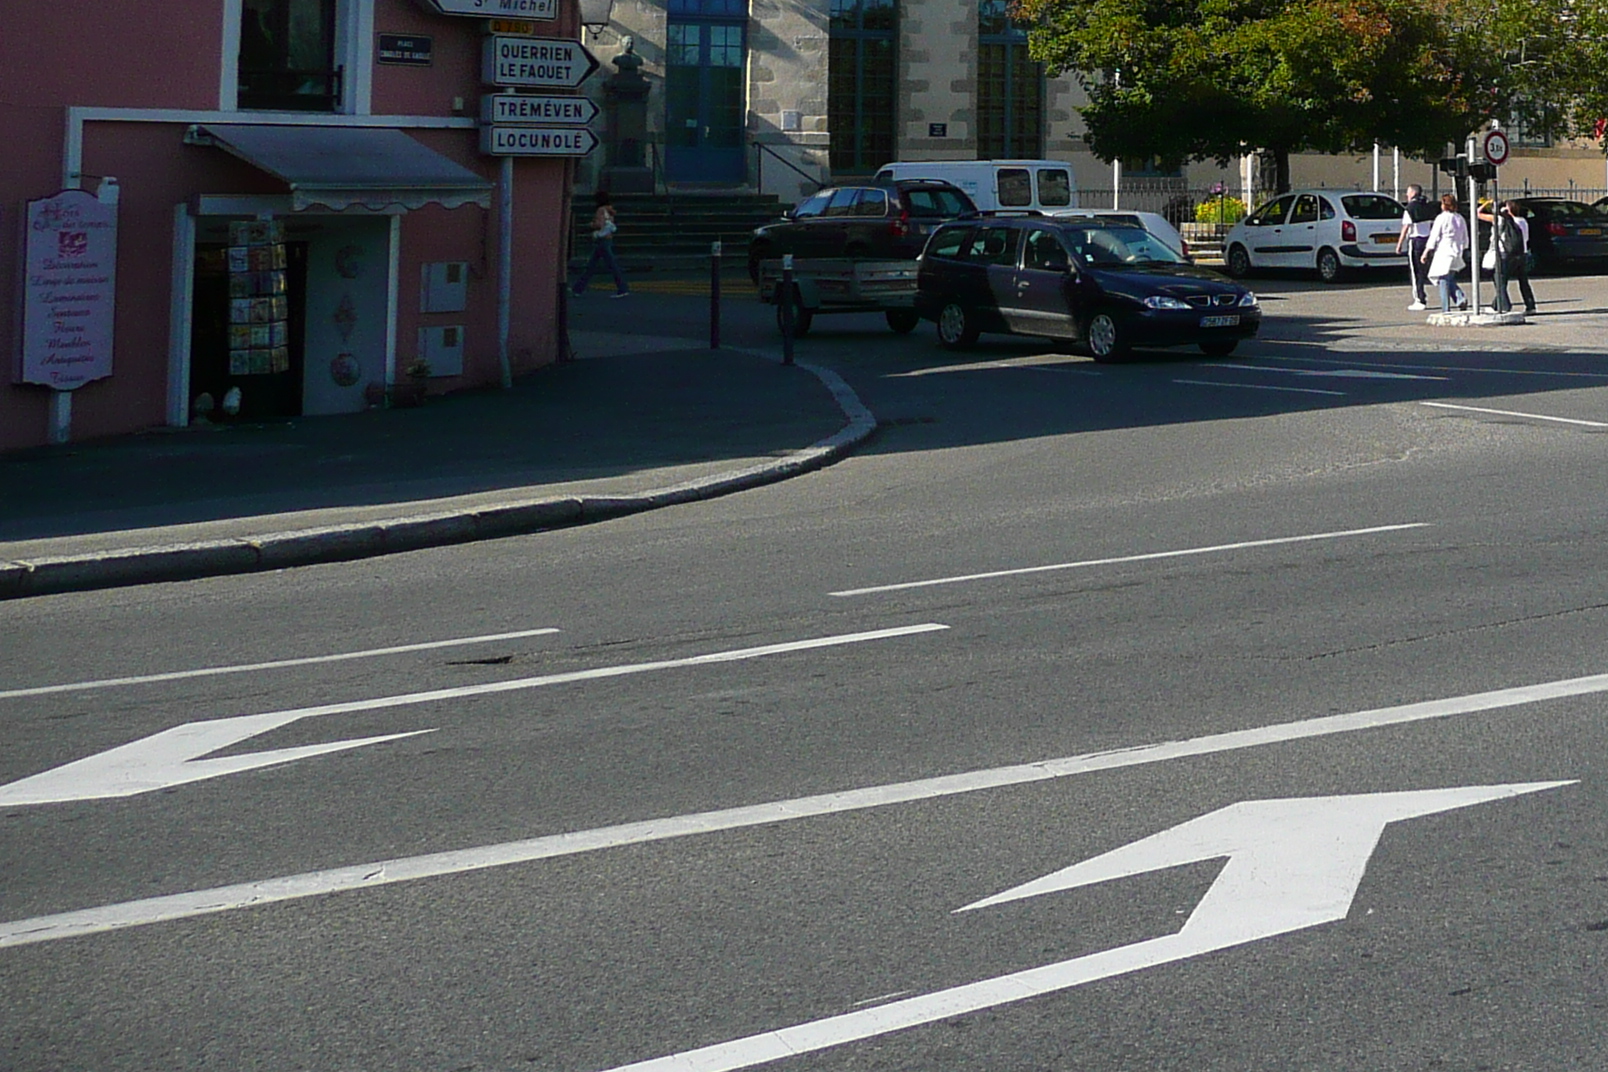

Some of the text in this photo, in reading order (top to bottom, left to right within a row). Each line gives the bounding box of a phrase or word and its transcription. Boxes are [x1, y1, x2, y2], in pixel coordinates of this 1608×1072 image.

[506, 22, 529, 33] 790
[501, 44, 573, 62] QUERRIEN
[500, 63, 516, 77] LE
[499, 100, 583, 118] TRÉMÉVEN
[498, 132, 583, 149] LOCUNOLÉ
